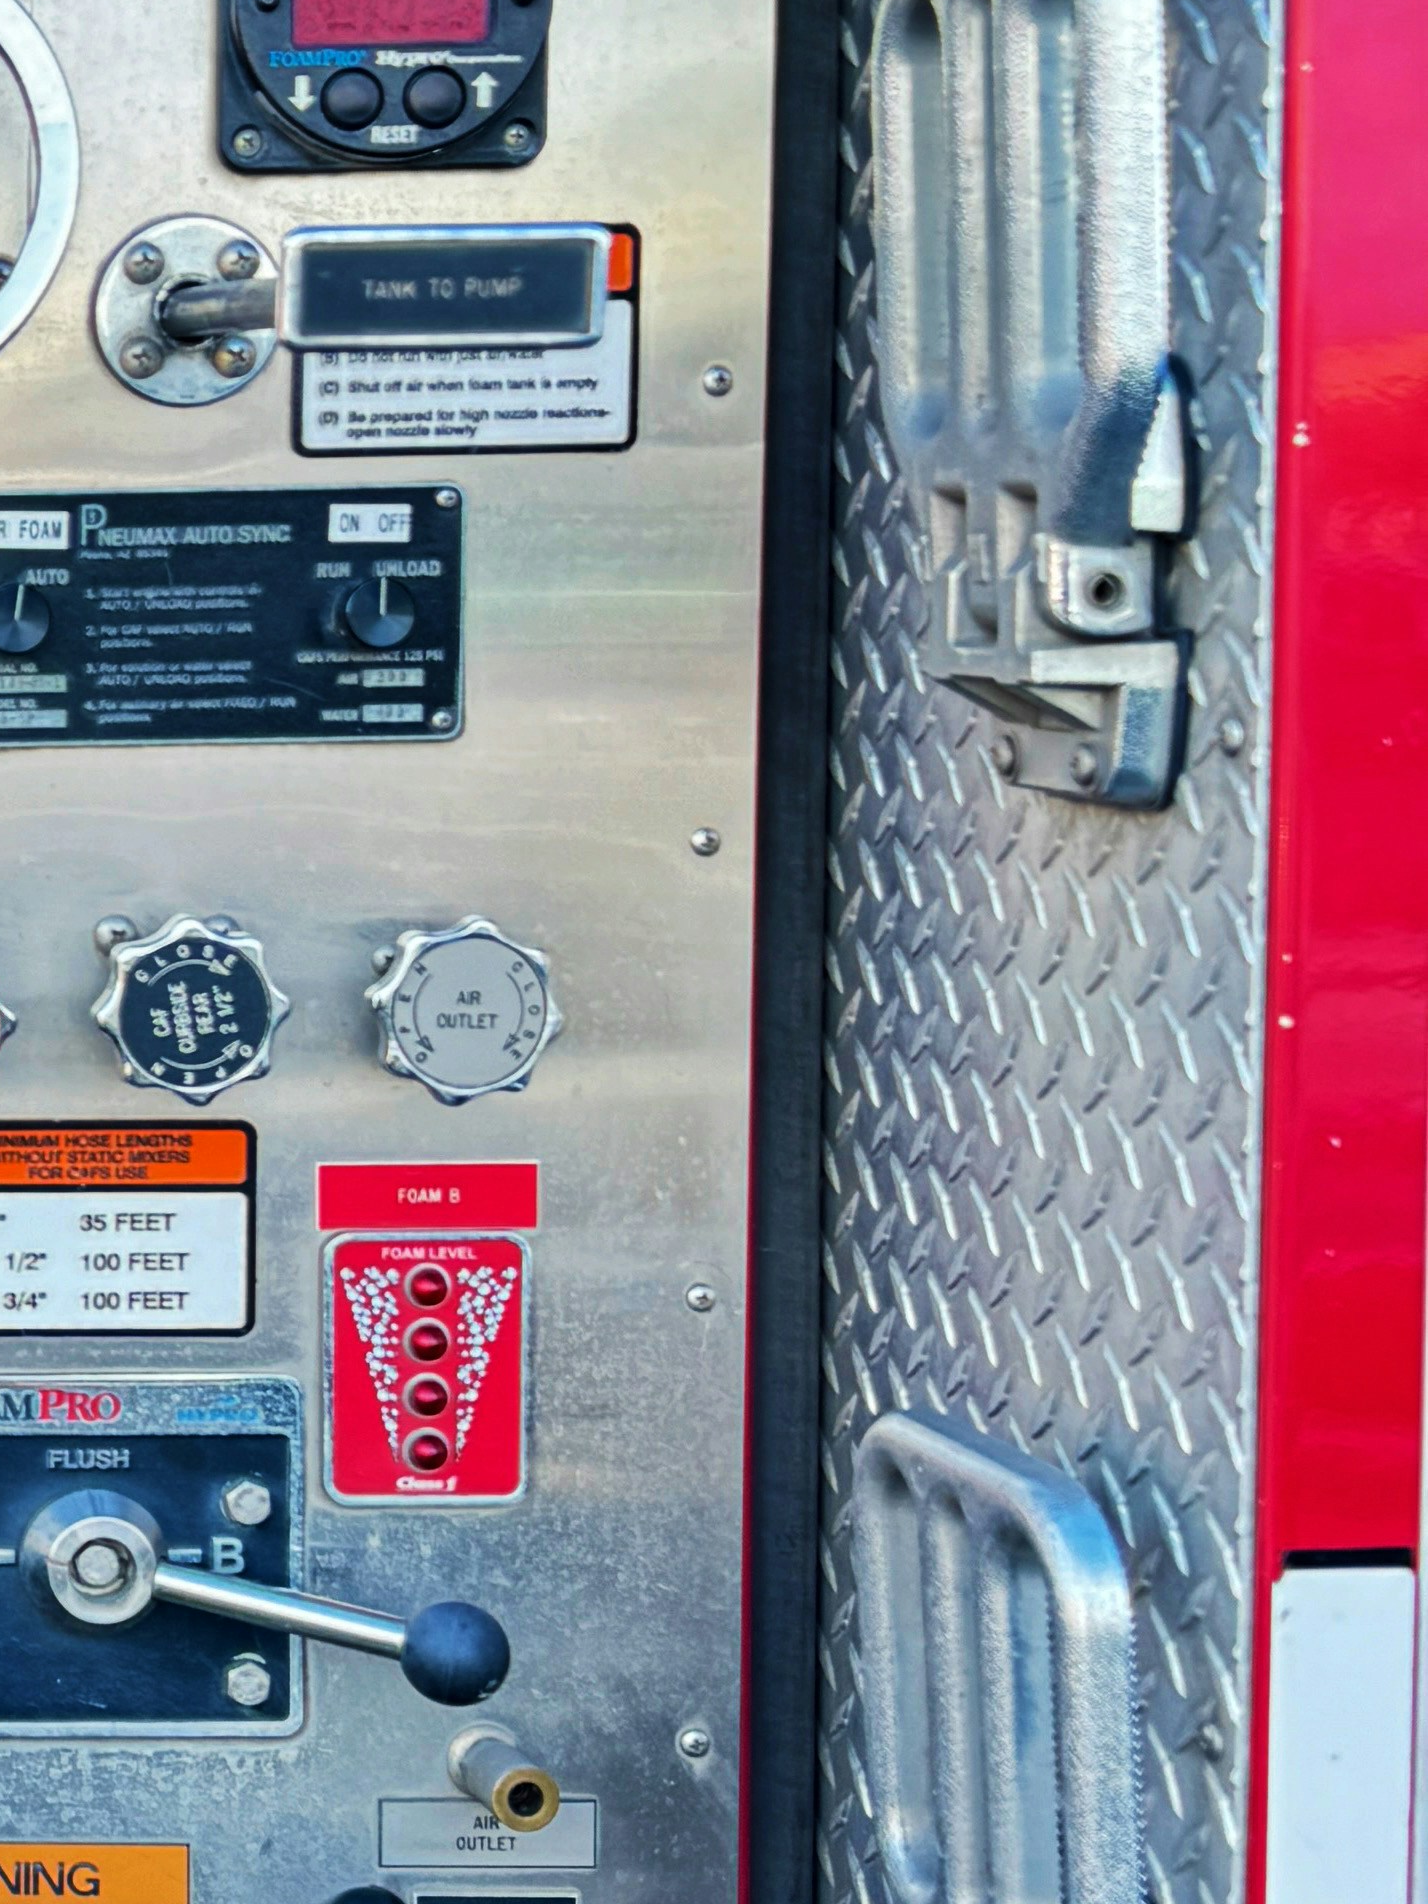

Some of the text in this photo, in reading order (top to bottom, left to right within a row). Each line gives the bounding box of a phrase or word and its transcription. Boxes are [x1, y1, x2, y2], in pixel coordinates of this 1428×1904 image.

[79, 1214, 110, 1232] 35
[115, 1214, 176, 1232] FEET
[4, 1253, 48, 1271] 1/2"
[81, 1253, 121, 1271] 100
[126, 1252, 190, 1271] FEET
[3, 1291, 47, 1310] 3/4"
[81, 1291, 121, 1310] 100
[126, 1291, 189, 1310] FEET
[48, 1449, 130, 1468] FLUSH
[212, 1538, 244, 1572] B
[456, 1837, 516, 1850] OUTLET
